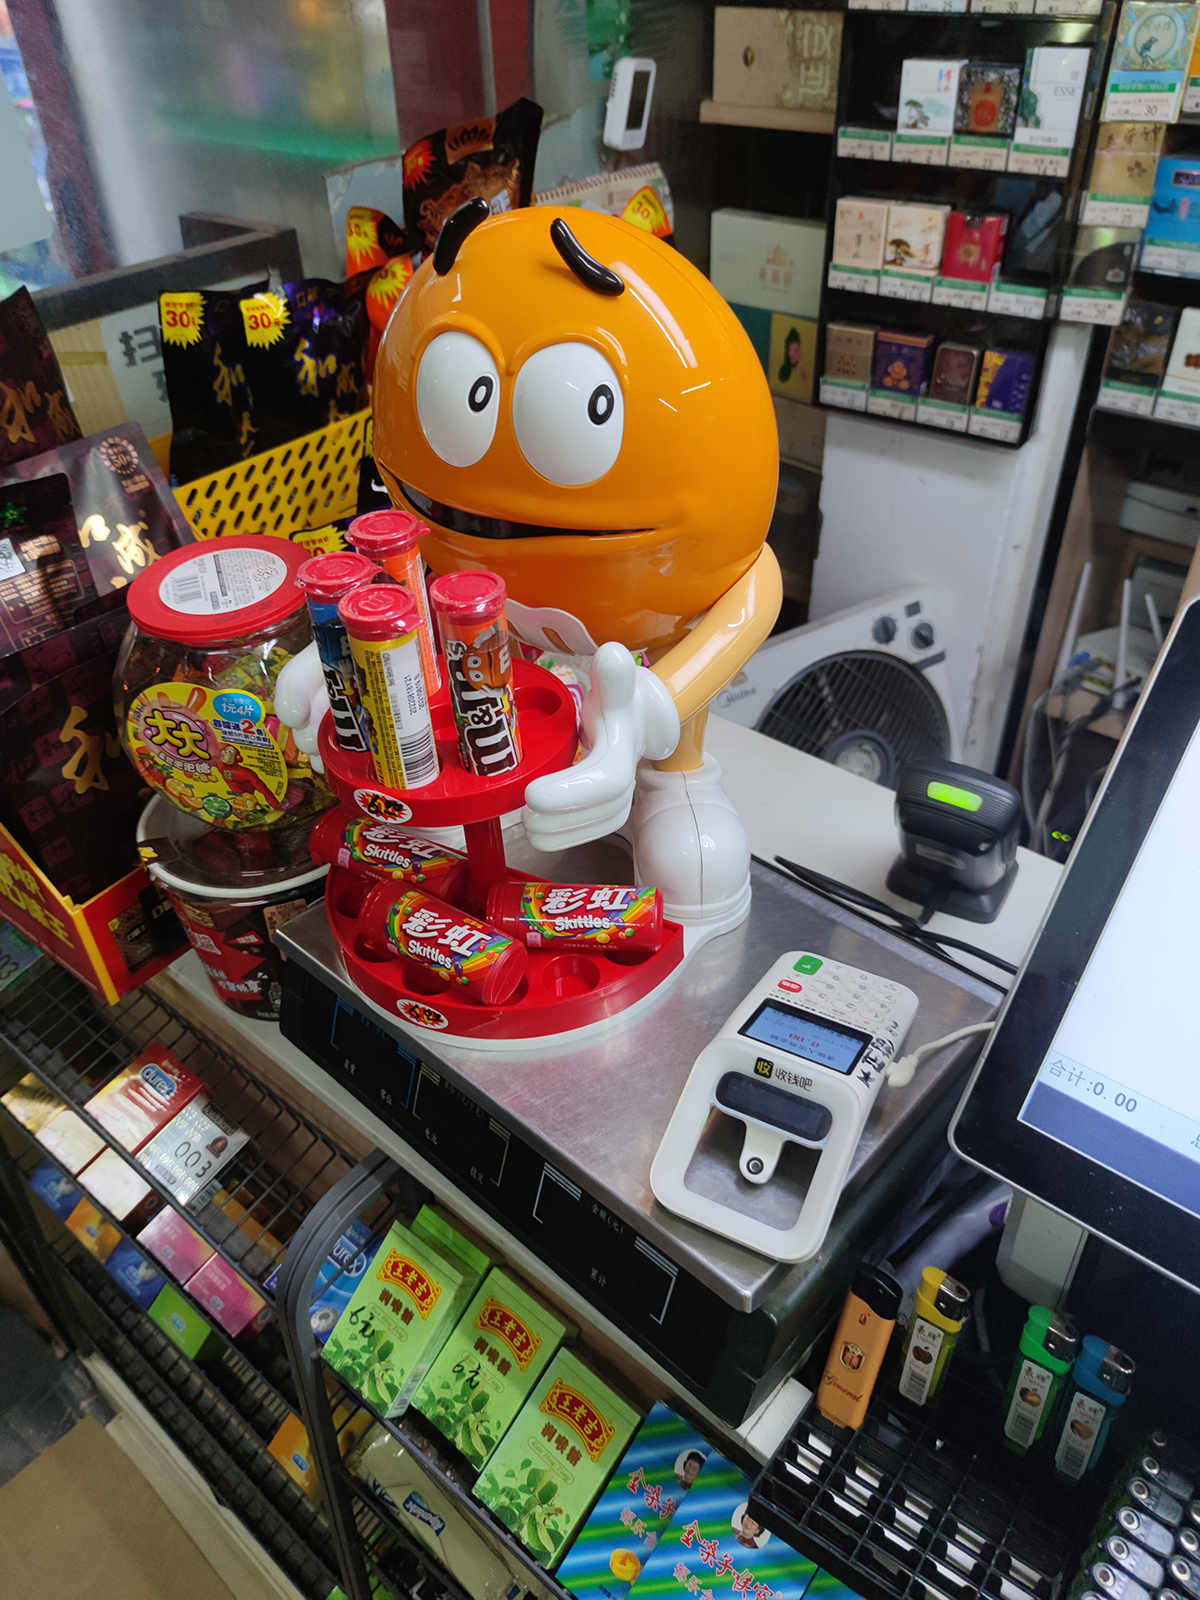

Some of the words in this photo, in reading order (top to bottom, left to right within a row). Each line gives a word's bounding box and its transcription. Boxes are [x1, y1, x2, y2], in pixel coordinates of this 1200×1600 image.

[1053, 85, 1078, 97] ESSE
[220, 703, 254, 717] 1元4片
[726, 686, 757, 704] Midea
[363, 842, 412, 869] Skittles
[540, 886, 638, 914] 彩虹
[402, 907, 493, 958] 彩虹
[554, 913, 612, 932] Skittles
[407, 939, 454, 969] Skittles
[142, 1066, 174, 1099] durex
[774, 1066, 814, 1093] 收钱吧
[174, 1140, 213, 1178] 003
[393, 1262, 428, 1298] 王老吉
[378, 1287, 415, 1326] 润喉糖
[489, 1310, 527, 1347] 王老吉
[473, 1335, 512, 1377] 润喉糖
[823, 1370, 864, 1403] General
[558, 1394, 599, 1435] 王老吉
[540, 1421, 583, 1467] 润喉糖
[627, 1467, 677, 1519] 金嗓子
[404, 1500, 444, 1536] Alpenliebe
